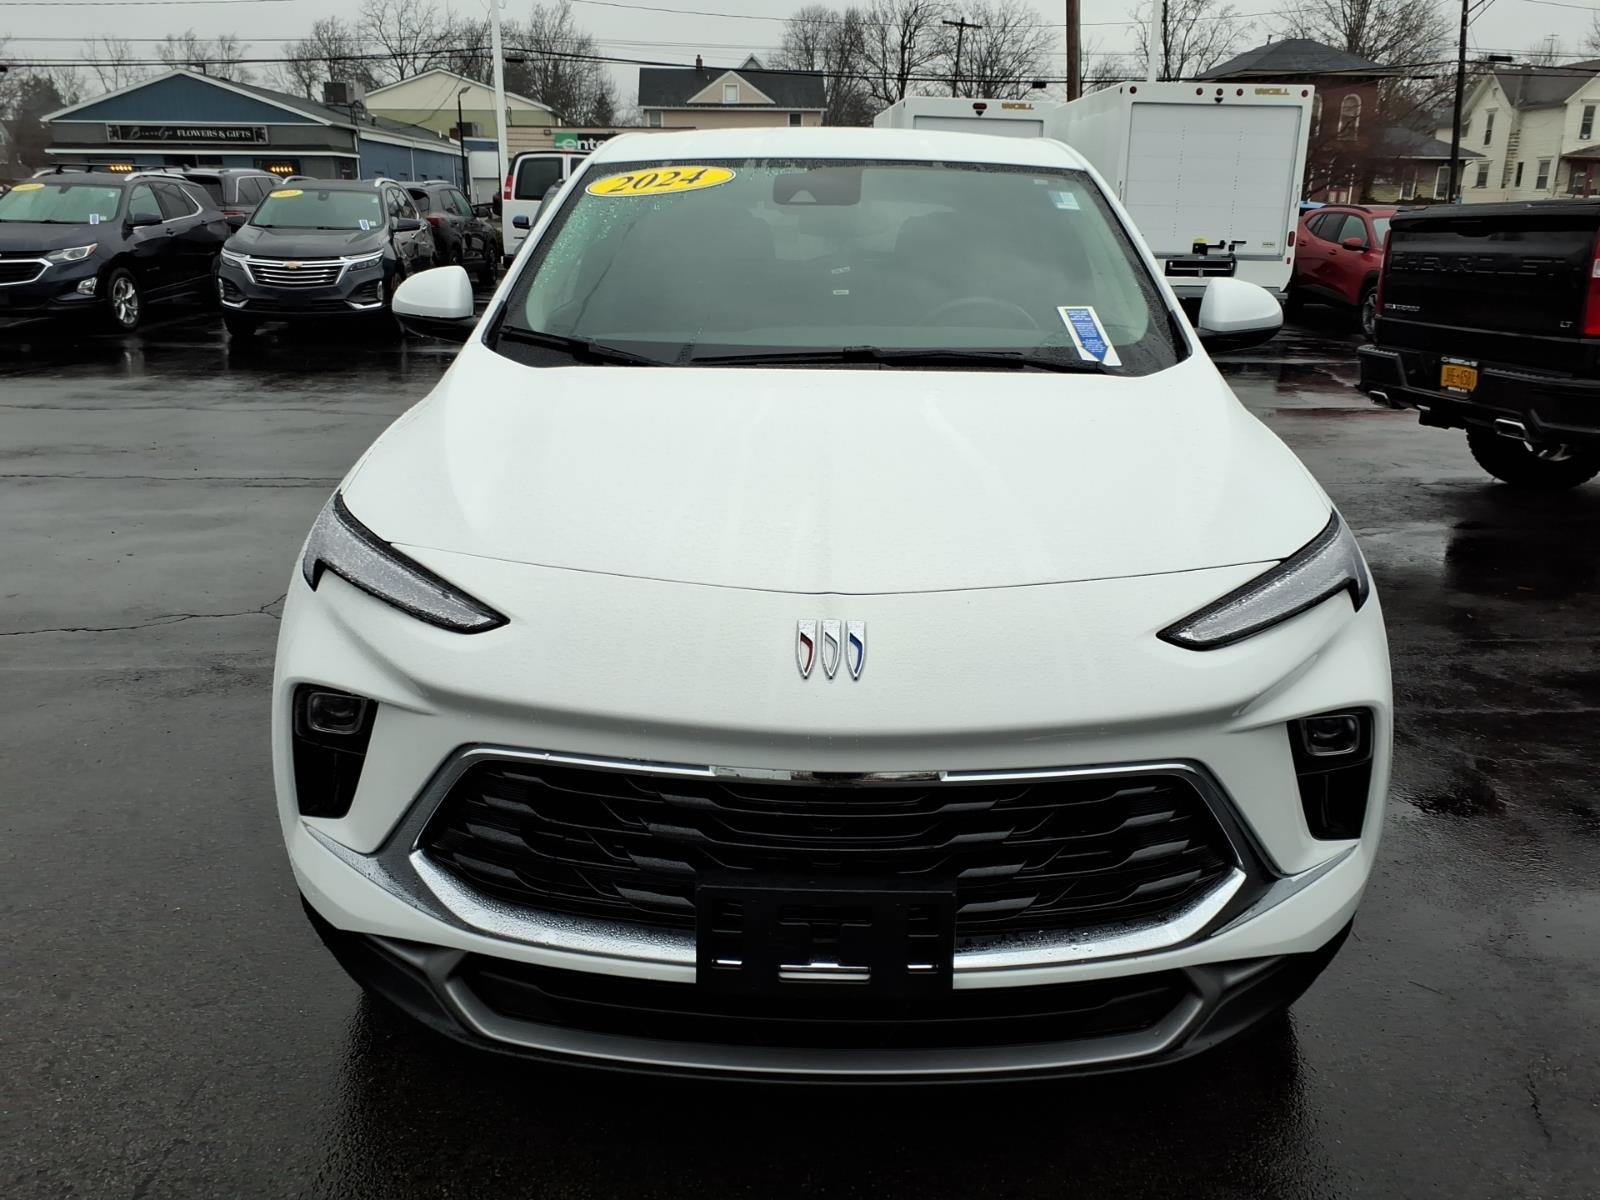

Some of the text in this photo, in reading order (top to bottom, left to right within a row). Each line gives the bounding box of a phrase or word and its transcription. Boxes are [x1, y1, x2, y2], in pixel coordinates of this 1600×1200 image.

[176, 129, 218, 138] FLOWERS
[218, 130, 226, 139] &
[226, 130, 251, 139] GIFTS
[606, 168, 708, 193] 2024
